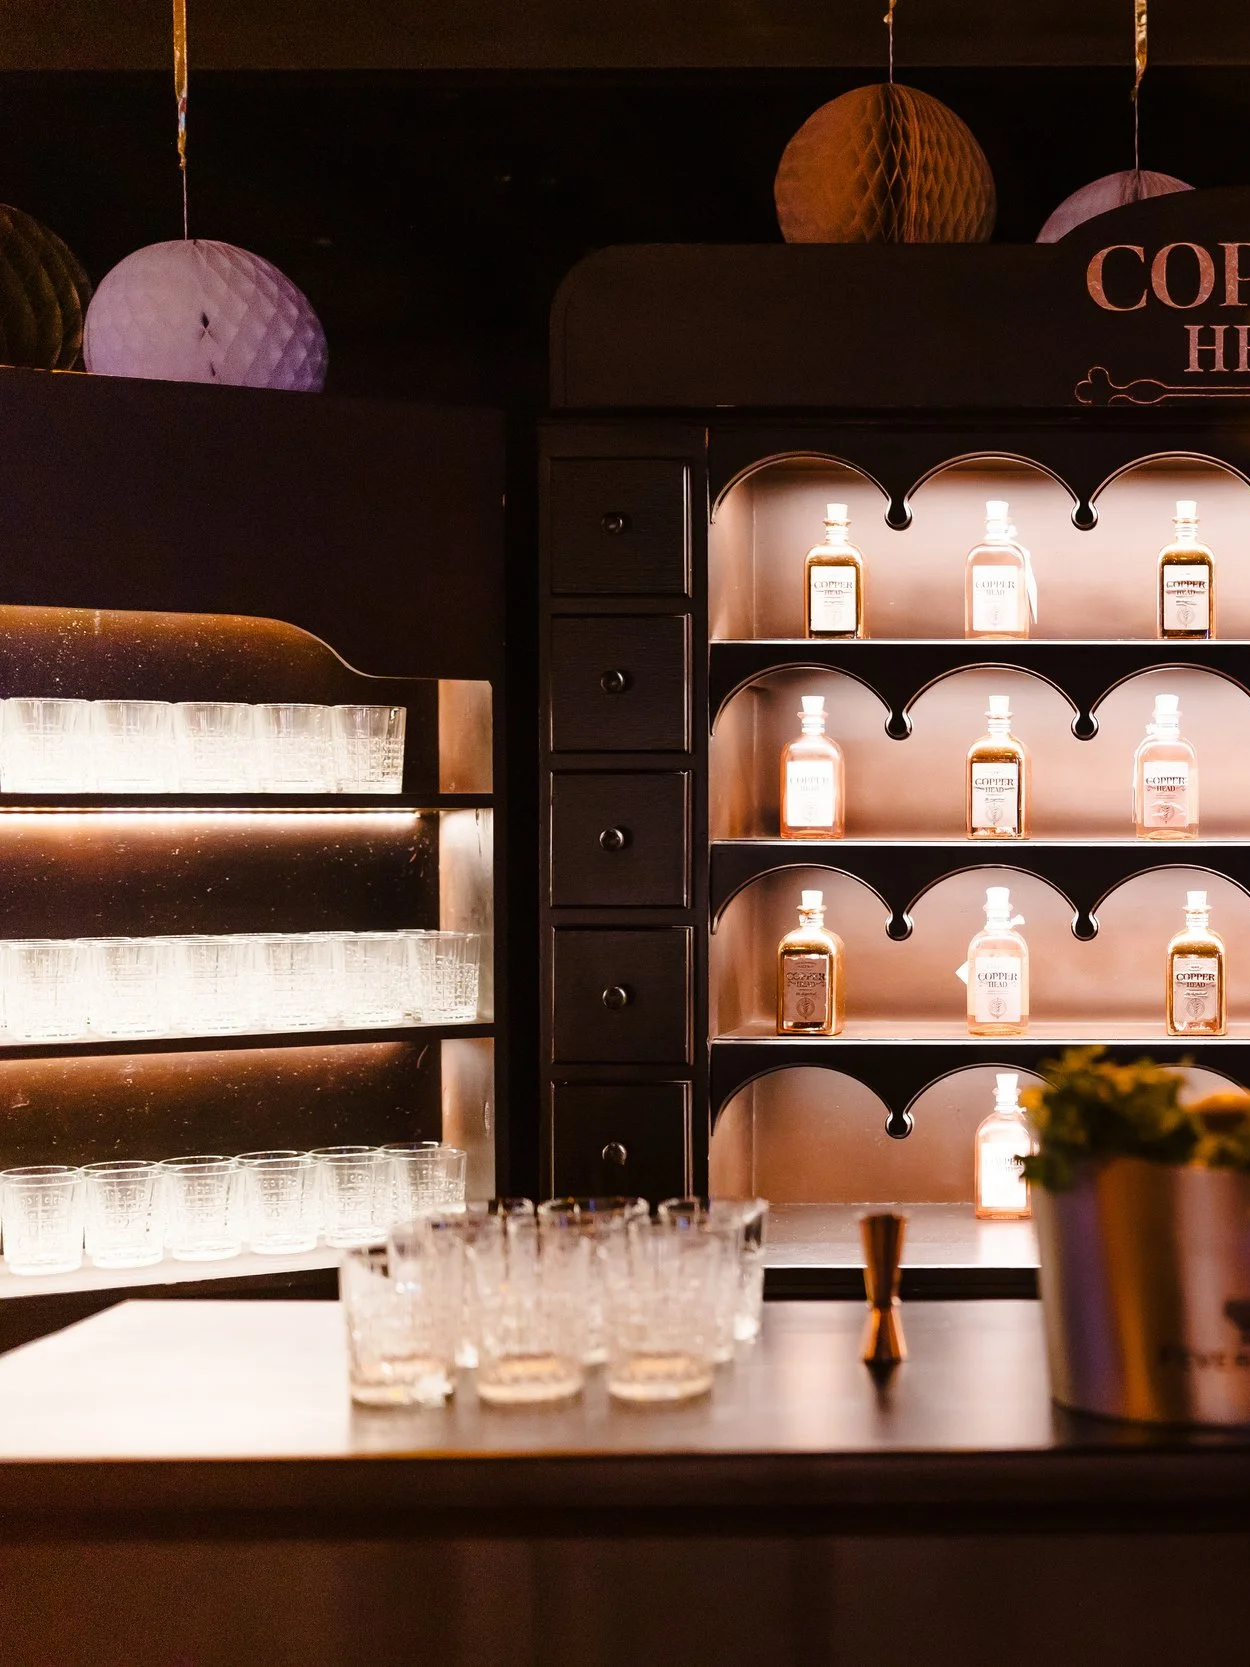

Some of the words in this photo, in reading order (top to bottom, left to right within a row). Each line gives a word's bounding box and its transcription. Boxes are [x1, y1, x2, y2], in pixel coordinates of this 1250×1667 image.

[813, 580, 853, 589] COPPER
[1166, 580, 1206, 589] COPPER
[974, 777, 1014, 786] COPPER
[1145, 776, 1185, 785] COPPER
[786, 972, 826, 981] COPPER
[977, 972, 1018, 981] COPPER
[1176, 972, 1215, 982] COPPER
